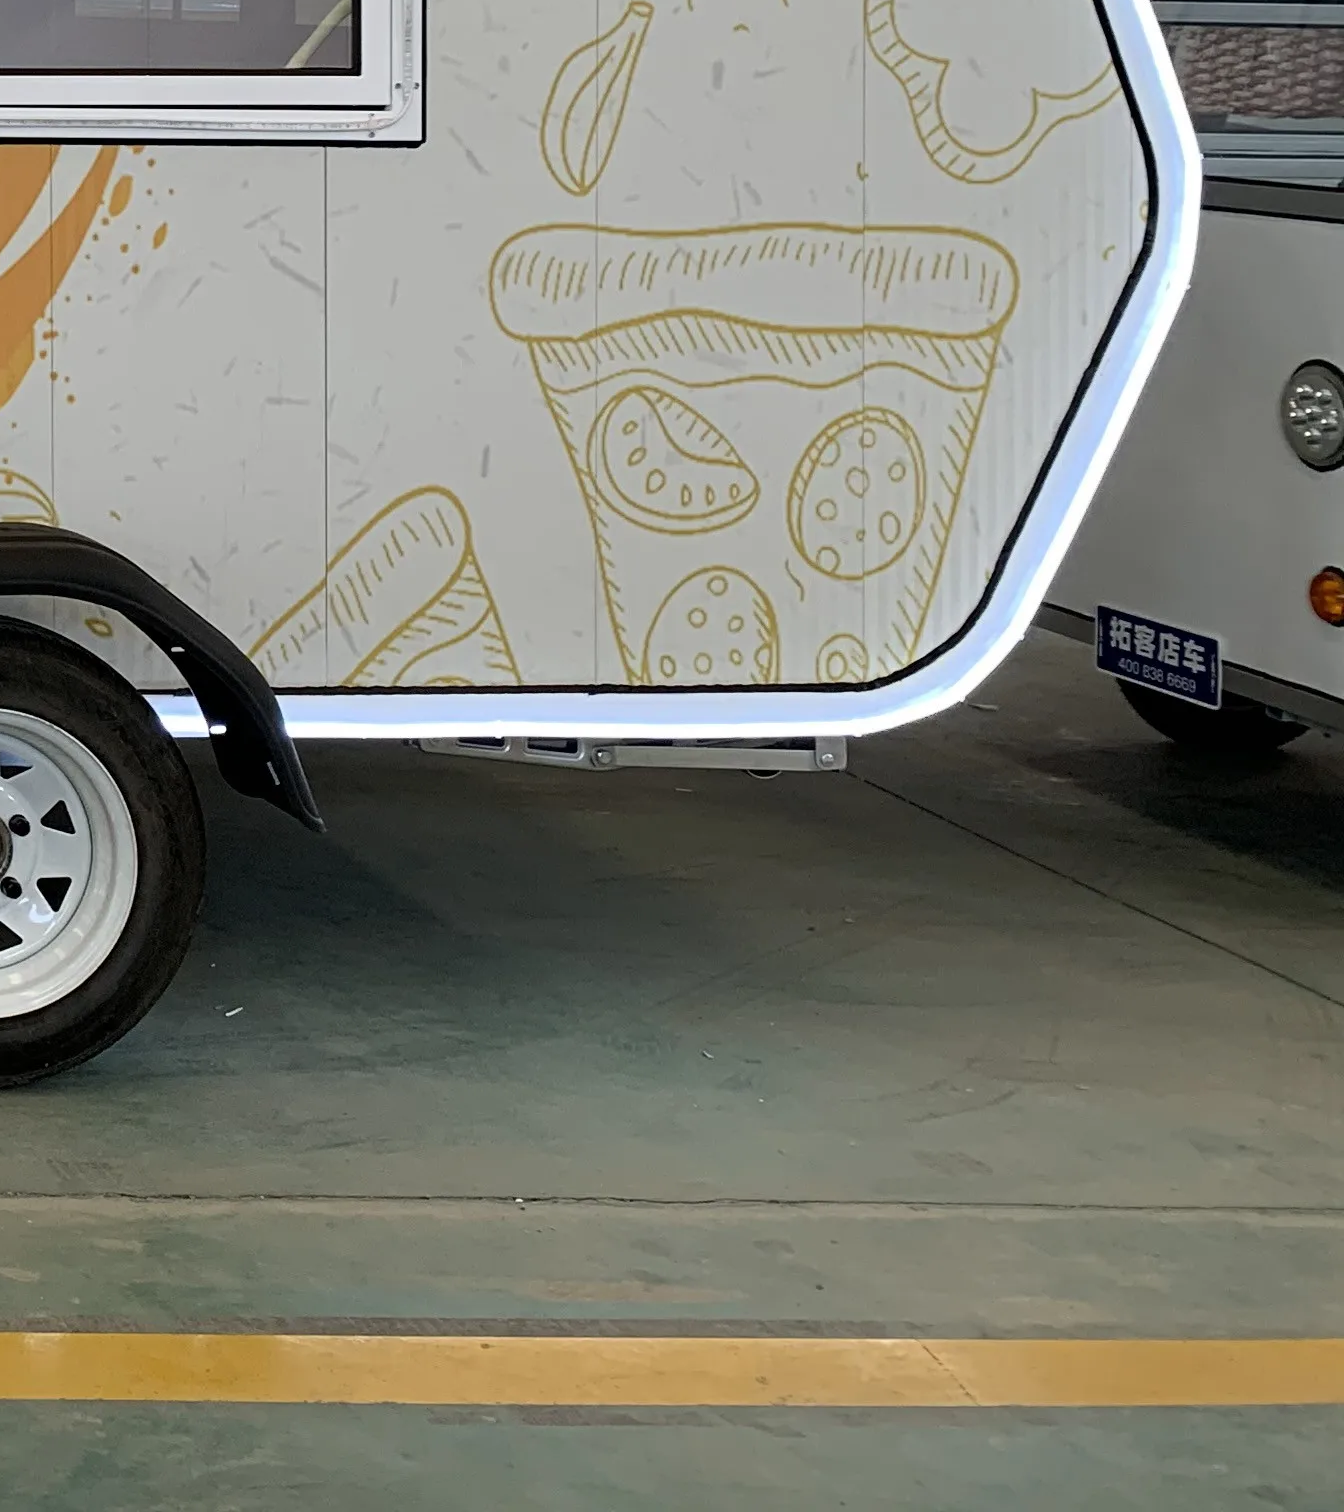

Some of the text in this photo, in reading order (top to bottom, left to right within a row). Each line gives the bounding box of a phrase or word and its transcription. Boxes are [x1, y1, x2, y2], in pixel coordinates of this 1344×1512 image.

[1109, 616, 1207, 674] 拓客店车
[1118, 657, 1140, 675] 400
